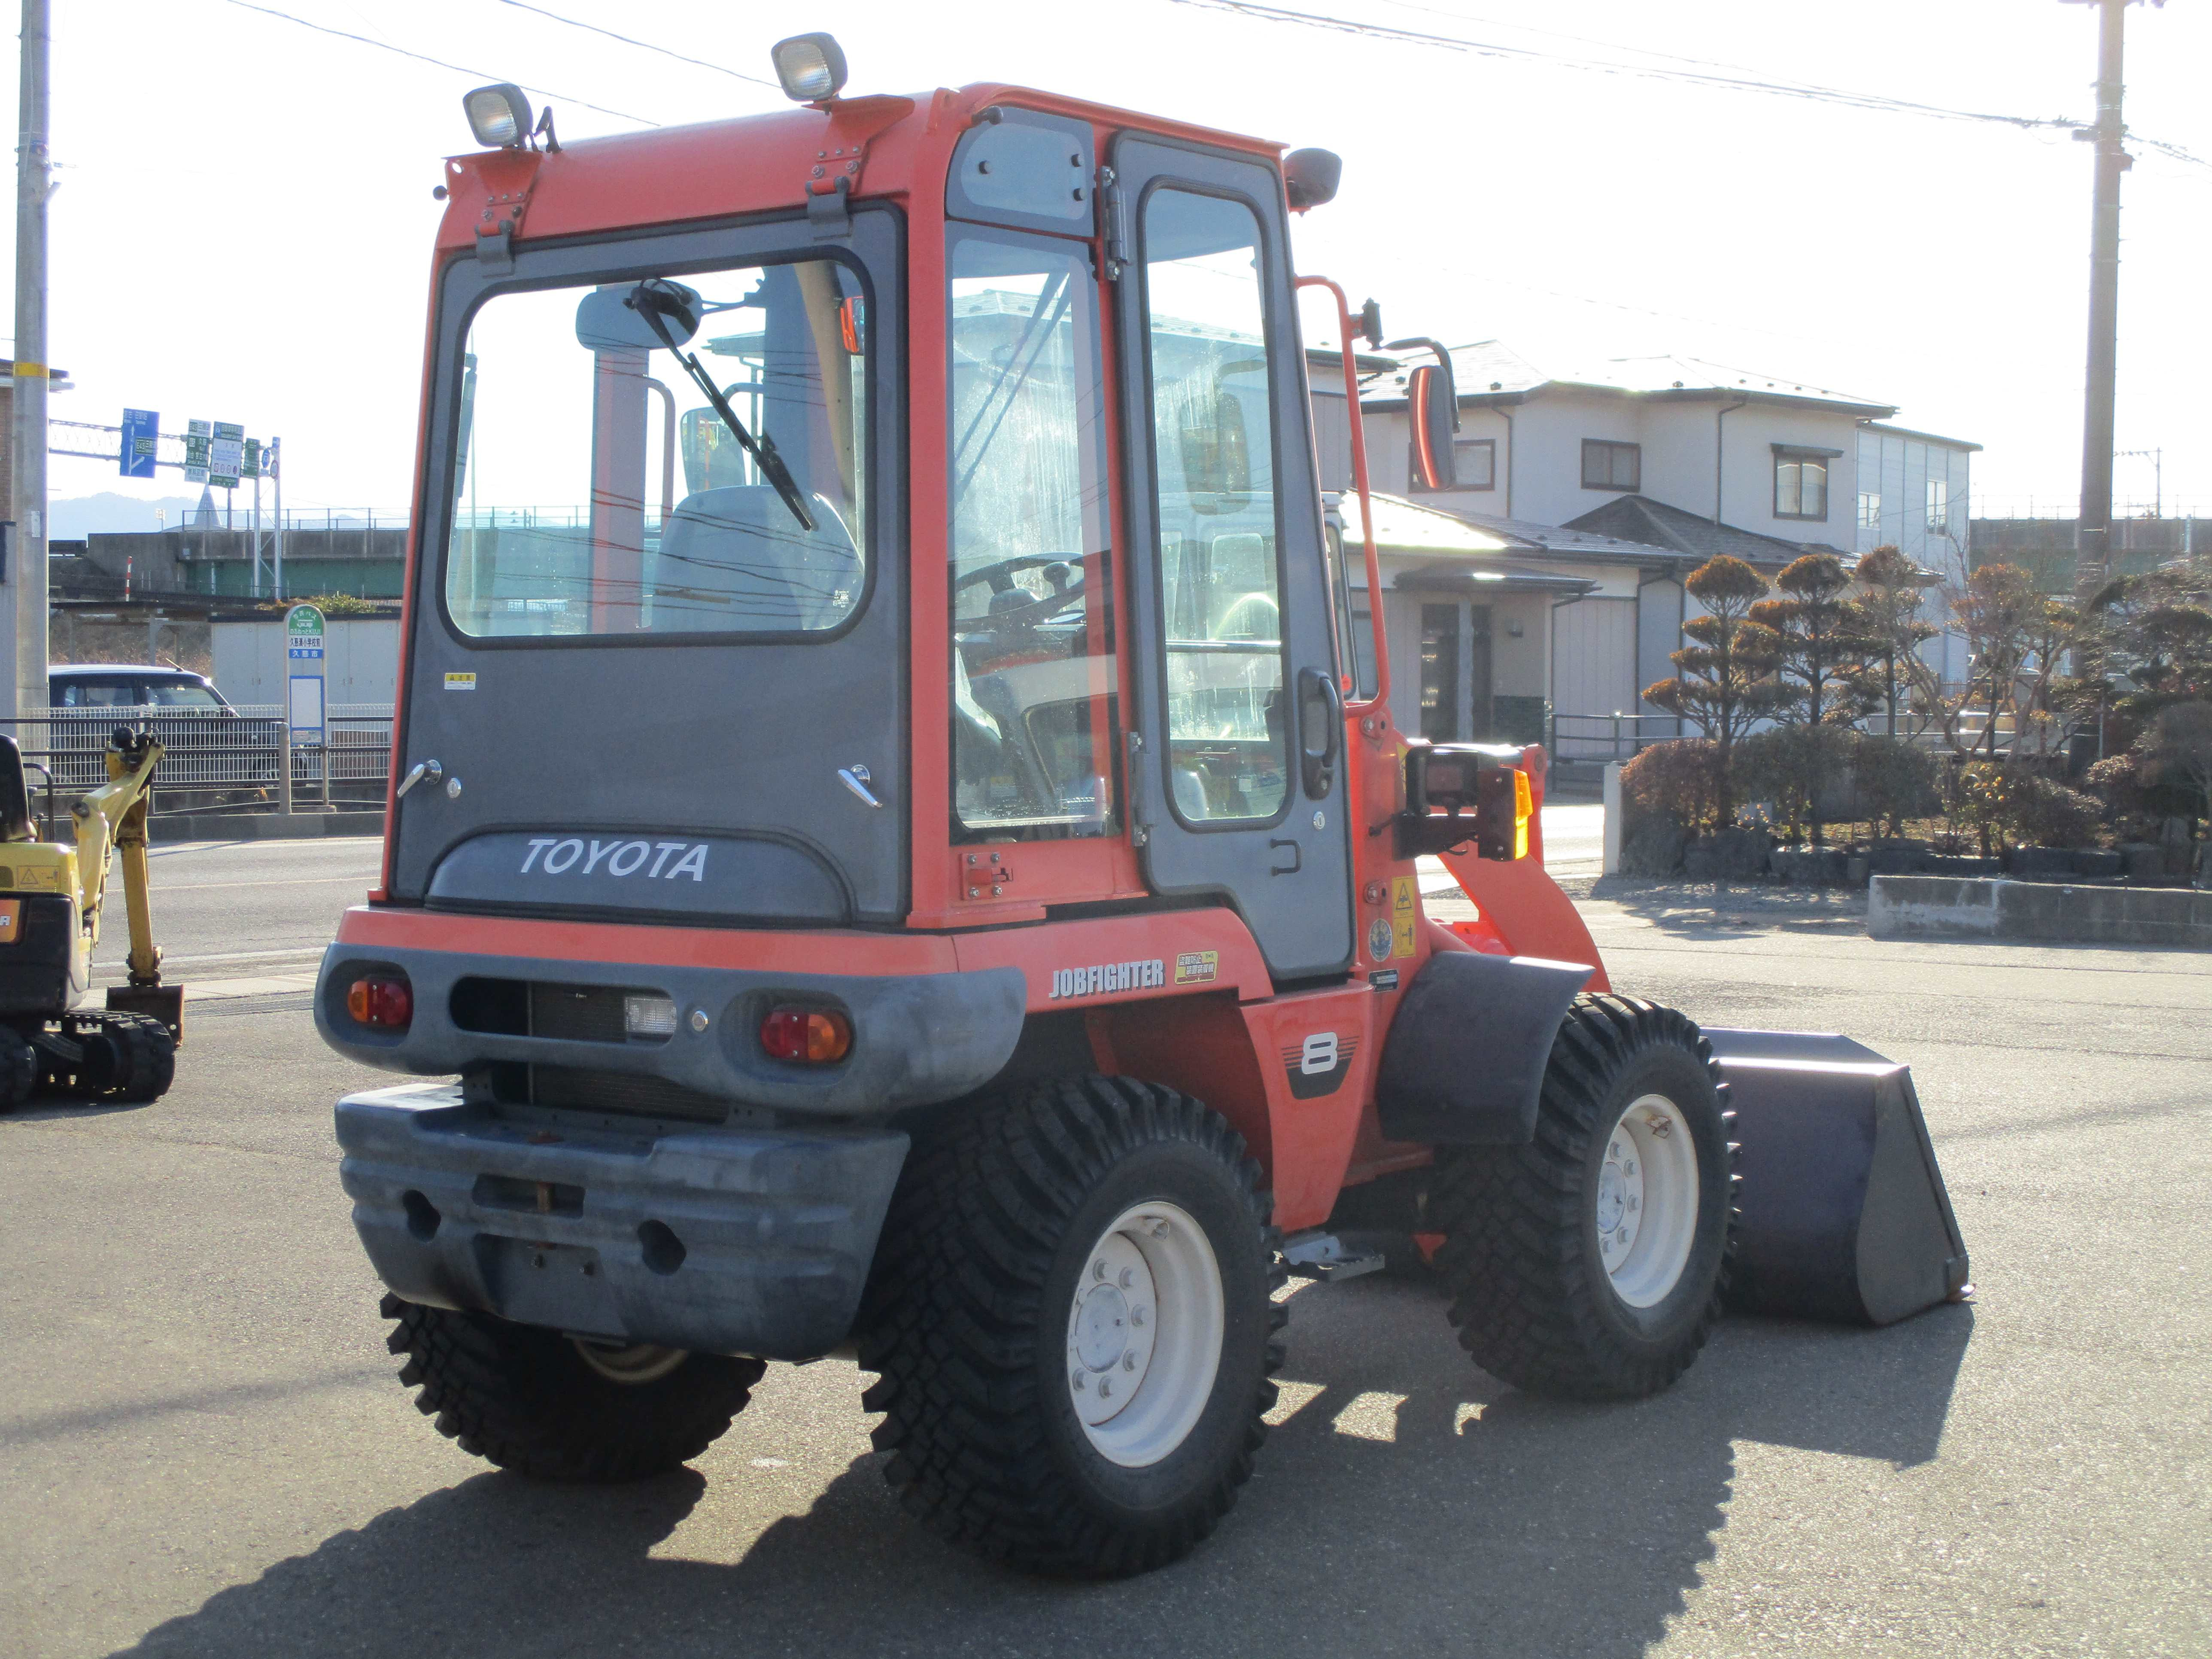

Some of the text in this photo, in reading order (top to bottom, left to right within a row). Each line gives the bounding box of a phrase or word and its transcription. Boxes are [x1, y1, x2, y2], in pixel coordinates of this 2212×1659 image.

[520, 839, 708, 881] TOYOTA
[1048, 959, 1164, 998] JOBFIGHTER
[1179, 955, 1201, 965] 盗難防止
[1301, 1031, 1338, 1075] 8
